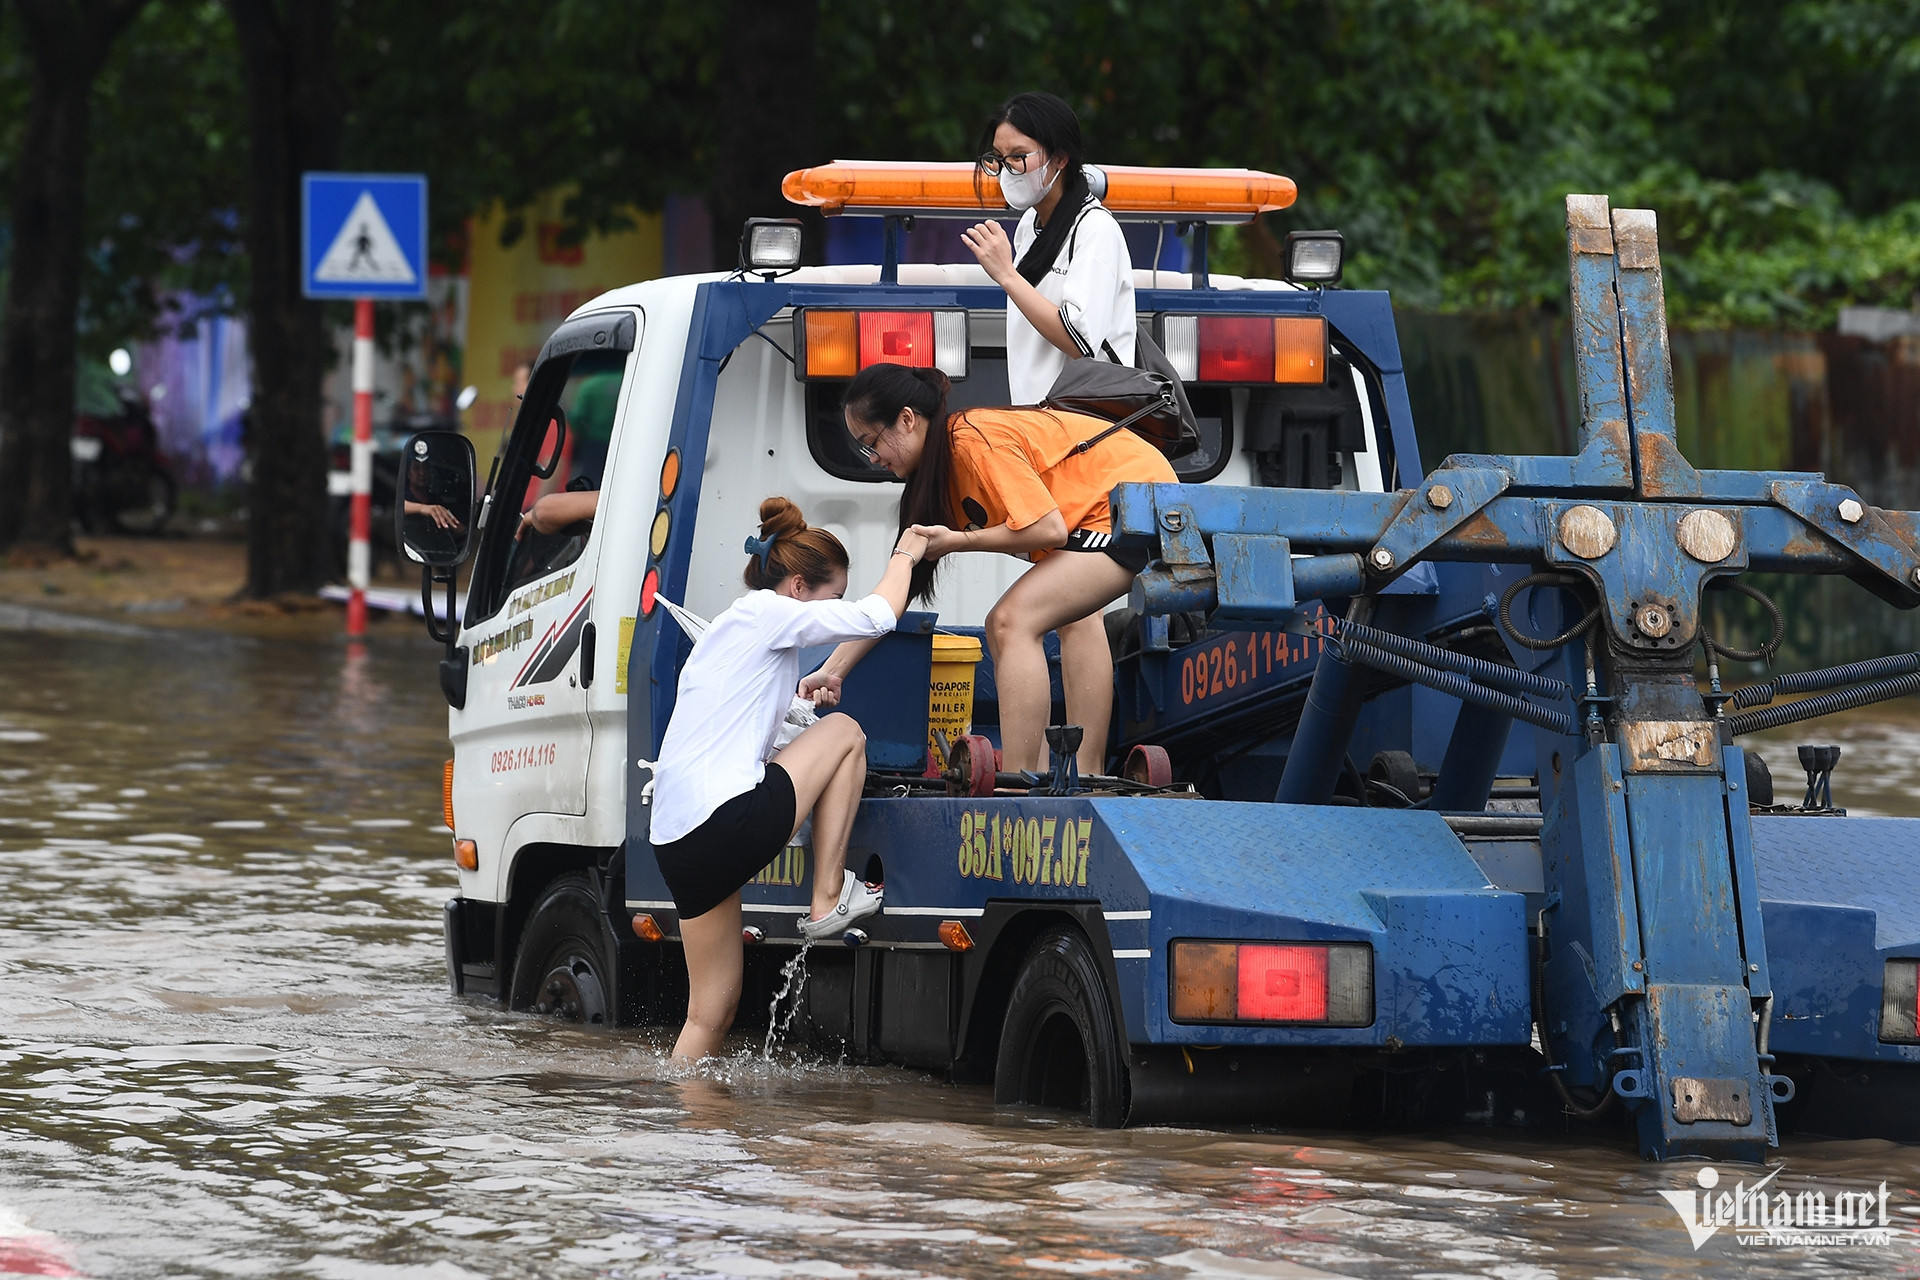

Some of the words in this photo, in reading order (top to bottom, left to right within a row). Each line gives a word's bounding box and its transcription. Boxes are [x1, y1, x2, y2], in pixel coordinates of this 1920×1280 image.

[1181, 605, 1340, 705] 0926.114.11
[930, 681, 971, 692] NGAPORE
[930, 727, 964, 737] 0W-50
[491, 743, 556, 774] 0926.114.116
